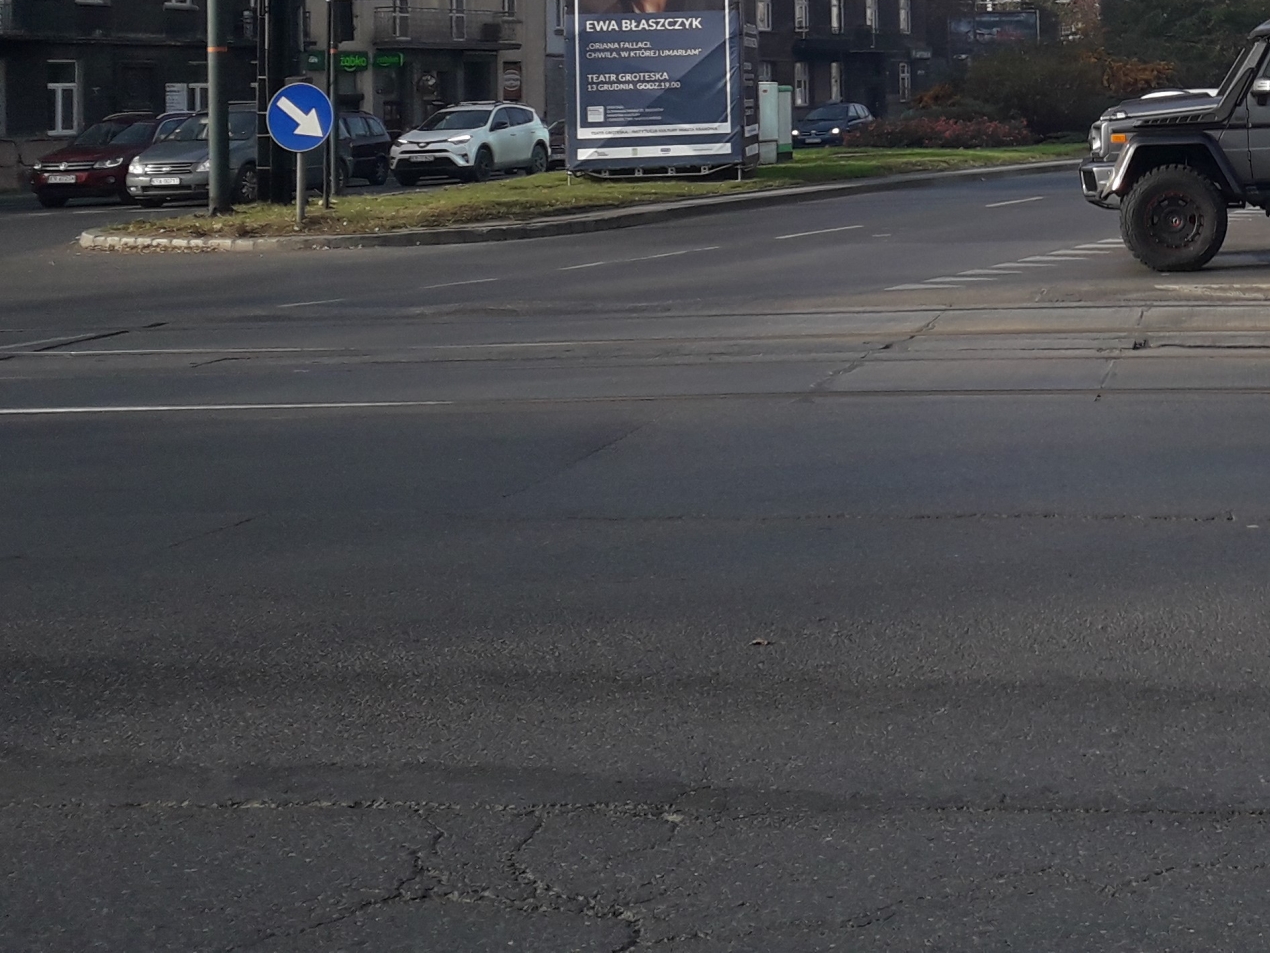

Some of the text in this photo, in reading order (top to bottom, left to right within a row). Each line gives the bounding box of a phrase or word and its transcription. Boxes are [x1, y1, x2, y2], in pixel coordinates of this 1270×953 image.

[586, 18, 702, 32] EWA BŁASZCZYK
[620, 50, 629, 58] W
[630, 48, 659, 57] KTÓREJ
[587, 72, 669, 83] TEATR GROTESKA
[587, 84, 597, 92] 13
[598, 83, 634, 91] GRUDNIA
